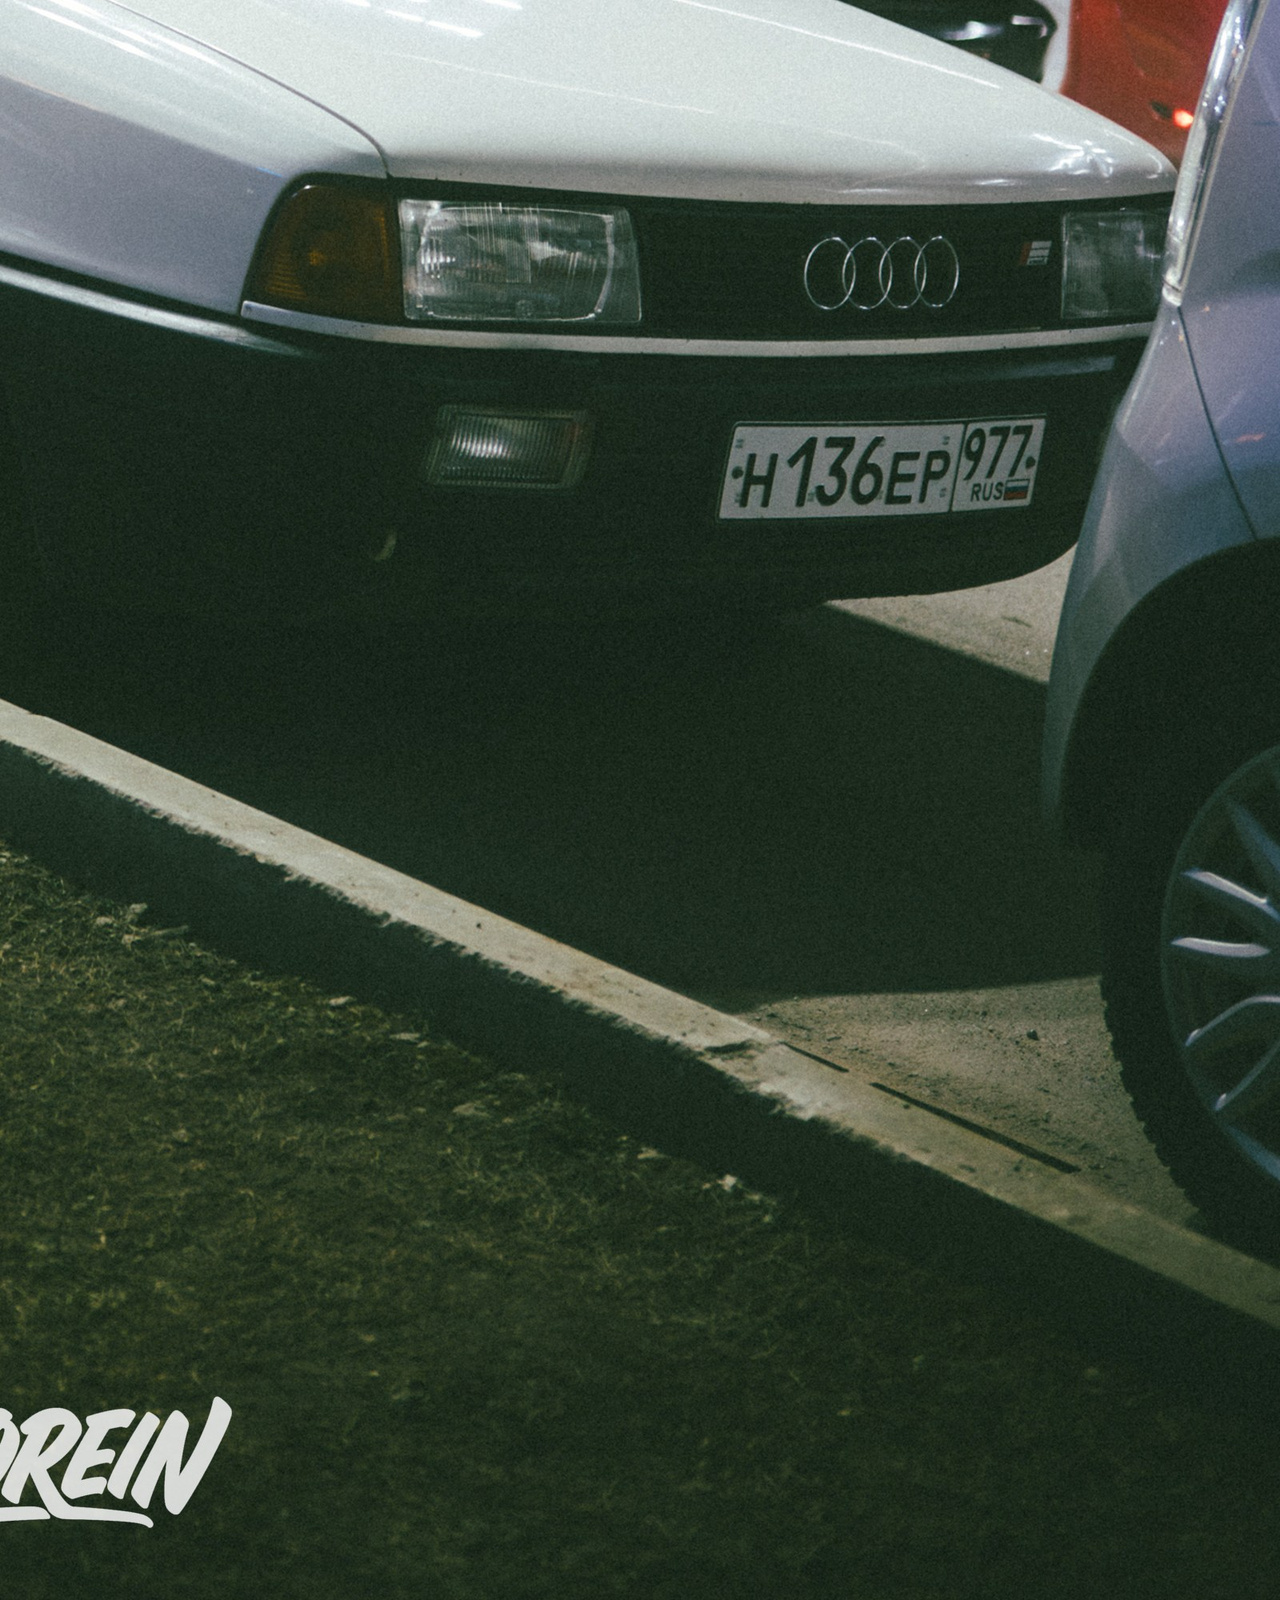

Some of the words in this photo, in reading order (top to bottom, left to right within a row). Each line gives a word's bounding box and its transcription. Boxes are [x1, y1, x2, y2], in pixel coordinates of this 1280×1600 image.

[738, 436, 951, 508] H136EP
[964, 424, 1034, 481] 977
[970, 483, 1004, 501] RUS
